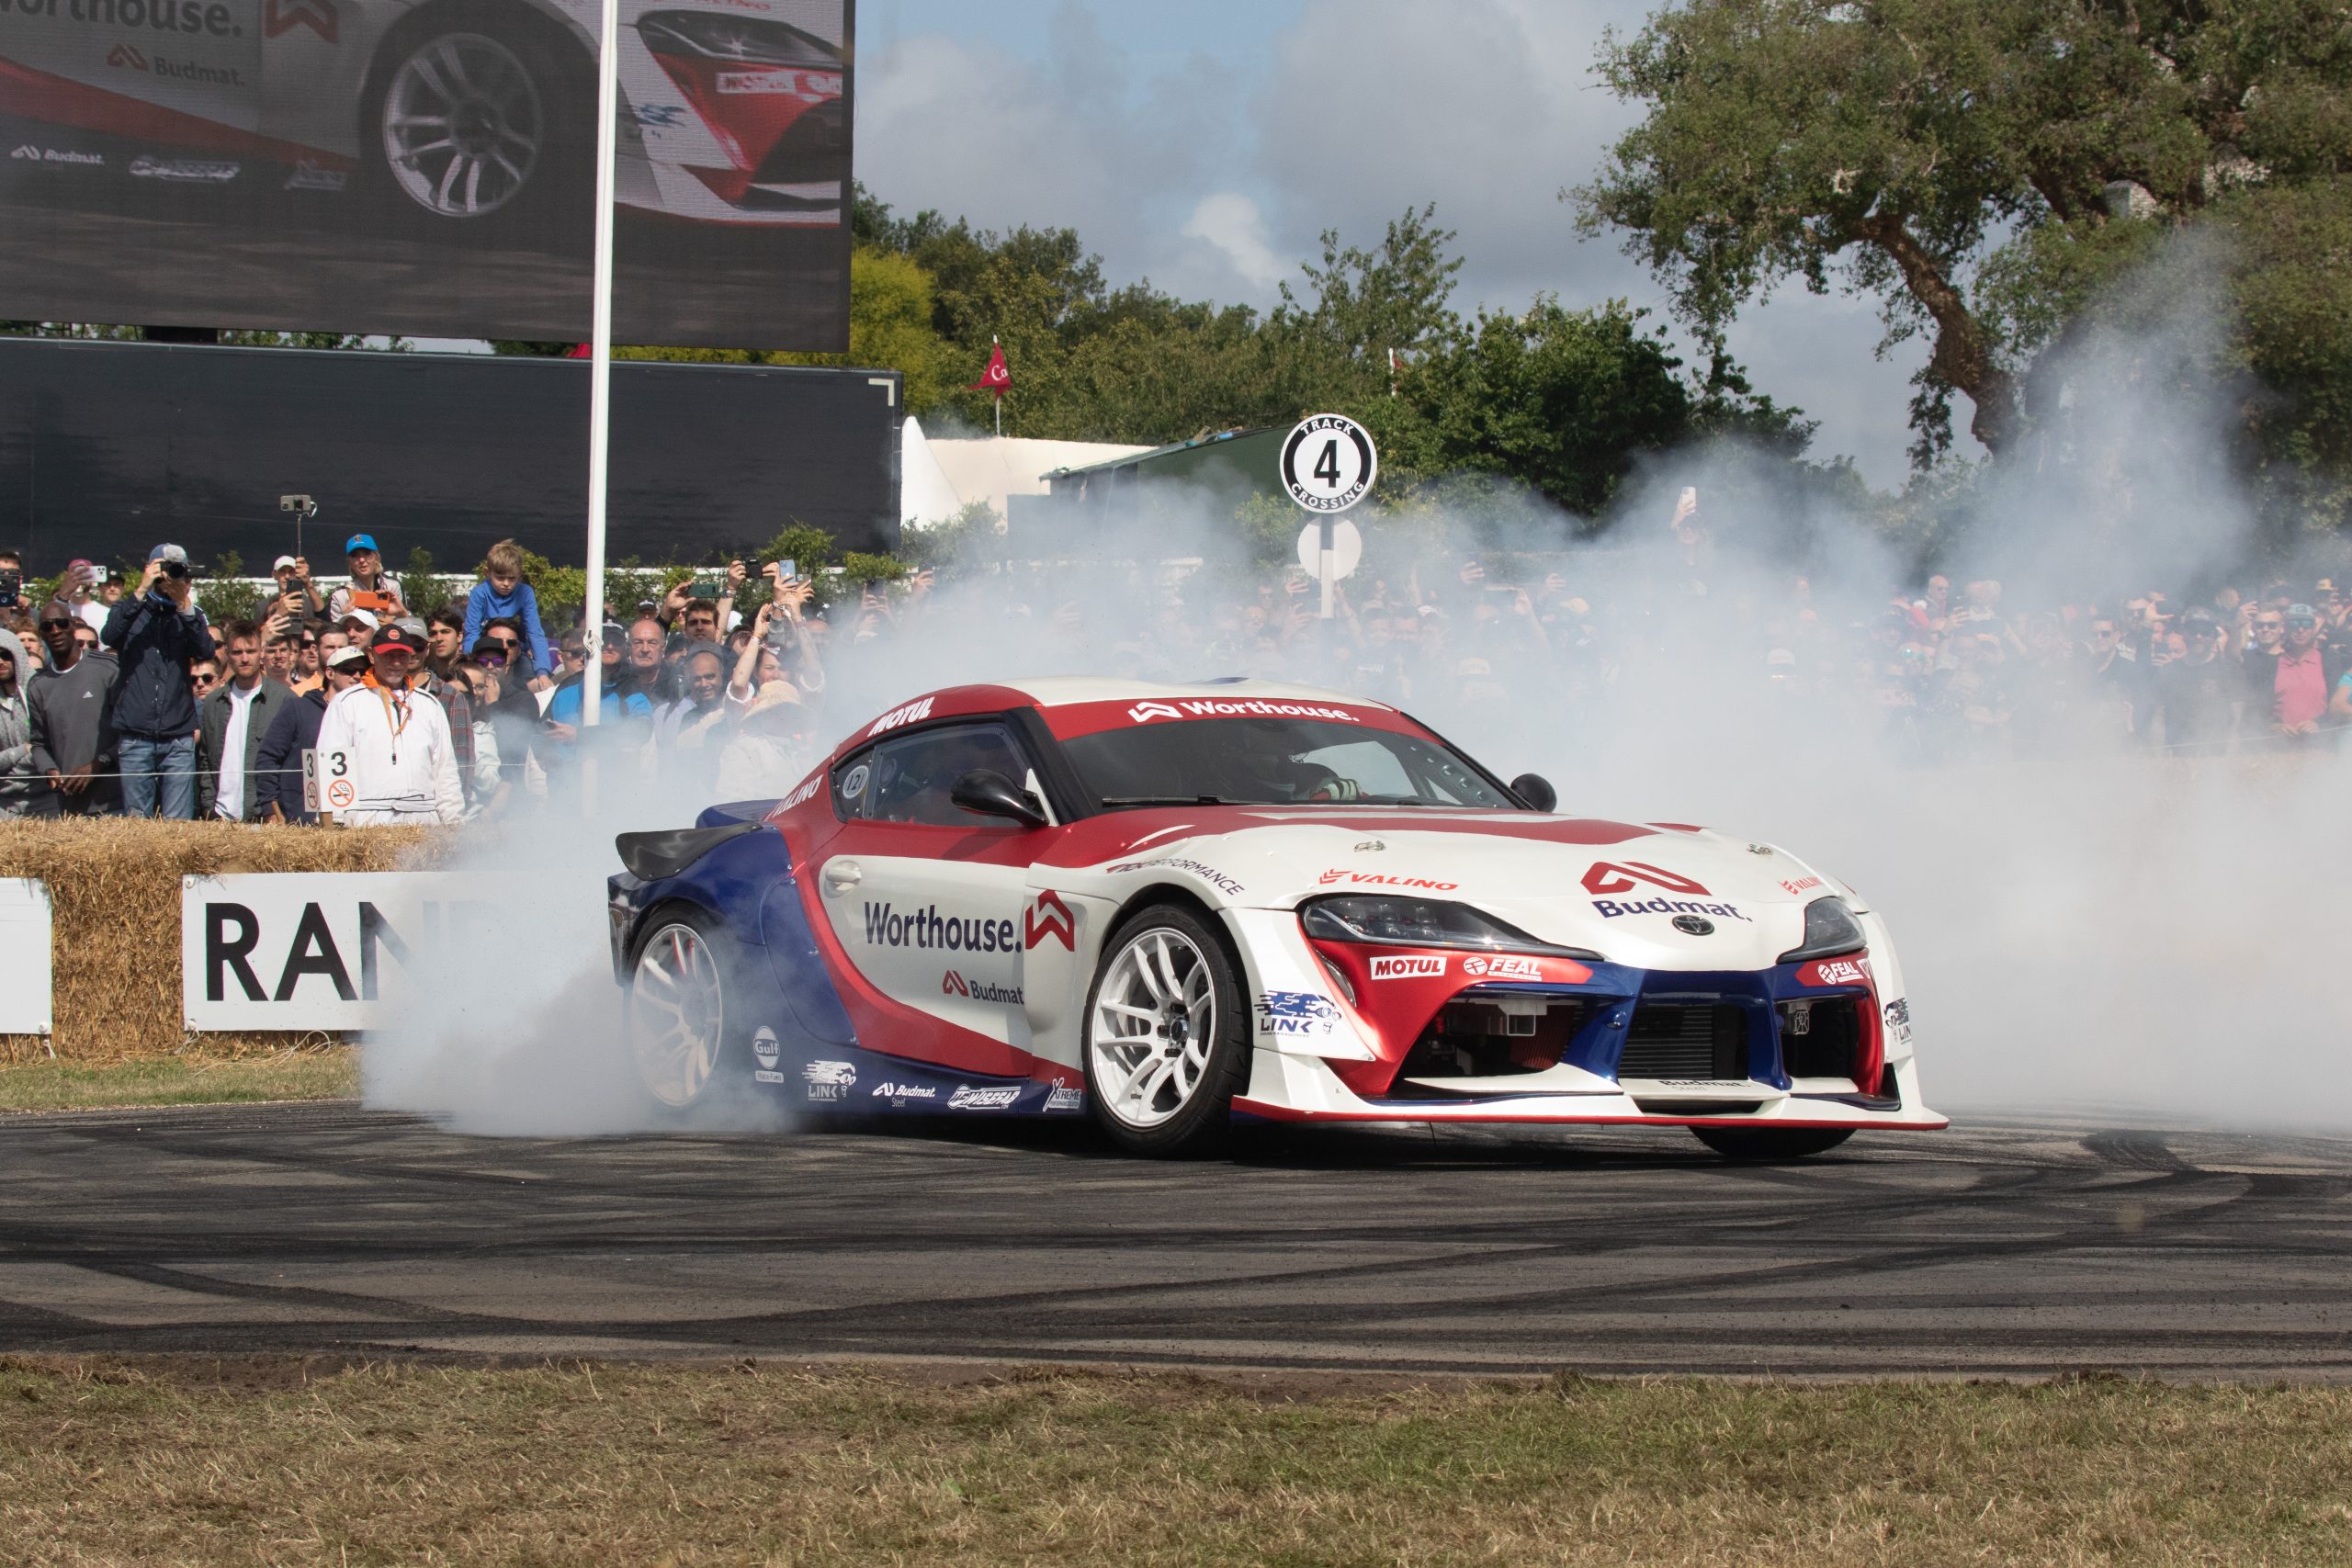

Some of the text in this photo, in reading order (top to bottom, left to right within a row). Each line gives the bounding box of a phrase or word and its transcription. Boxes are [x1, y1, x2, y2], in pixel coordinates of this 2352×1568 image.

[153, 56, 246, 86] Budmat.
[1300, 418, 1354, 435] TRACK
[1313, 439, 1340, 488] 4
[1291, 481, 1364, 510] CROSSING
[867, 696, 935, 738] MOTUL
[1179, 701, 1360, 722] Worthouse.
[306, 753, 314, 777] 3
[331, 751, 348, 777] 3
[1351, 874, 1460, 891] VALINO
[1591, 897, 1754, 922] Budmat.
[864, 901, 1023, 953] Worthouse.
[205, 901, 473, 1002] RAN
[1374, 959, 1442, 976] MOTUL
[1488, 958, 1542, 976] FEAL
[1829, 961, 1860, 977] FEAL
[969, 979, 1025, 1005] Budmat
[1260, 1017, 1314, 1033] LINK
[1898, 1024, 1911, 1041] LIN
[754, 1040, 779, 1055] Gulf
[808, 1085, 838, 1098] LINK
[895, 1084, 936, 1098] Budmat.
